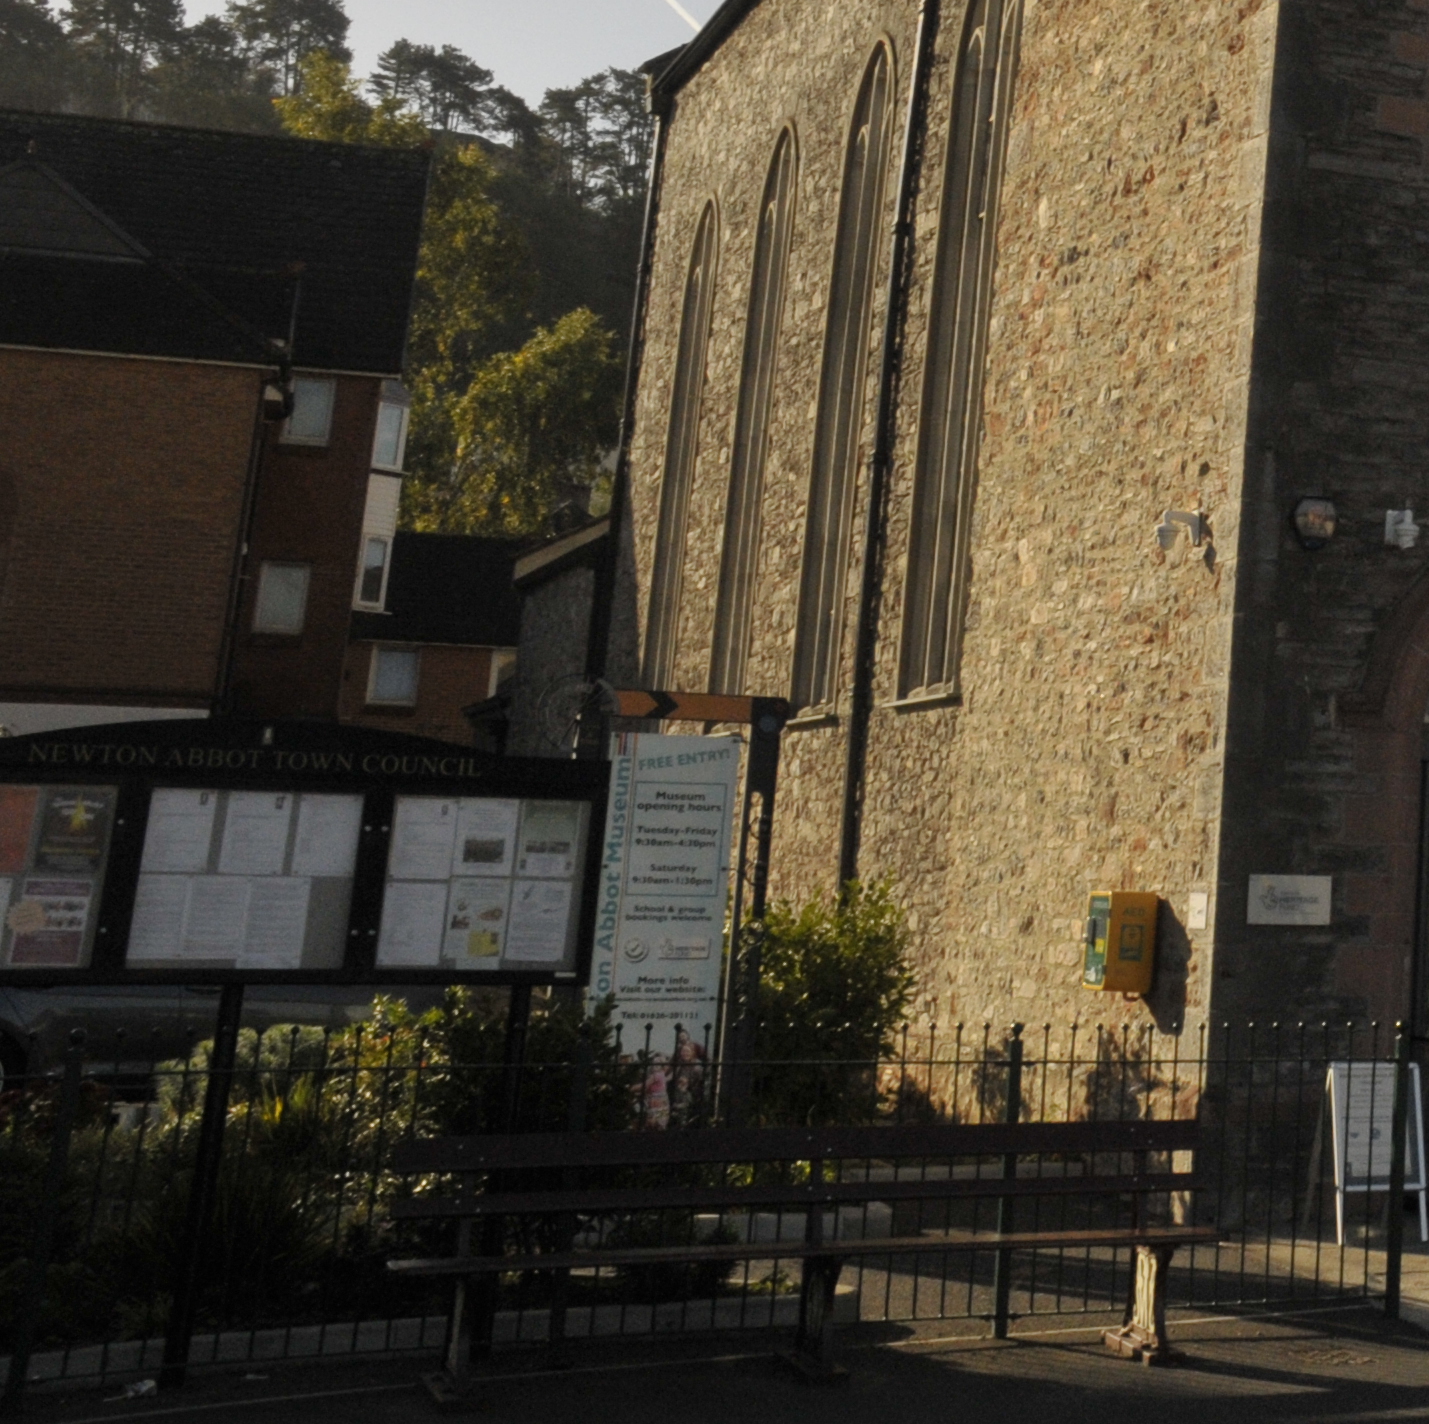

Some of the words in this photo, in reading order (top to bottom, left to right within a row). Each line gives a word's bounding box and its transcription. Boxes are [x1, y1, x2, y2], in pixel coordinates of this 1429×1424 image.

[28, 743, 158, 766] NEWTON
[164, 747, 261, 770] ABBOT
[273, 750, 354, 772] TOWN
[361, 753, 482, 778] COUNCIL
[638, 755, 673, 771] FREE
[677, 748, 730, 767] ENTRY!
[655, 791, 706, 801] Museum
[606, 757, 632, 864] Museum
[637, 802, 685, 813] opening
[688, 802, 722, 812] hours
[650, 863, 697, 874] Saturday
[597, 872, 621, 953] Abbot
[634, 904, 665, 914] School
[678, 906, 706, 916] group
[625, 914, 668, 923] bookings
[638, 976, 666, 985] More
[669, 976, 690, 985] info
[620, 985, 642, 994] Visit
